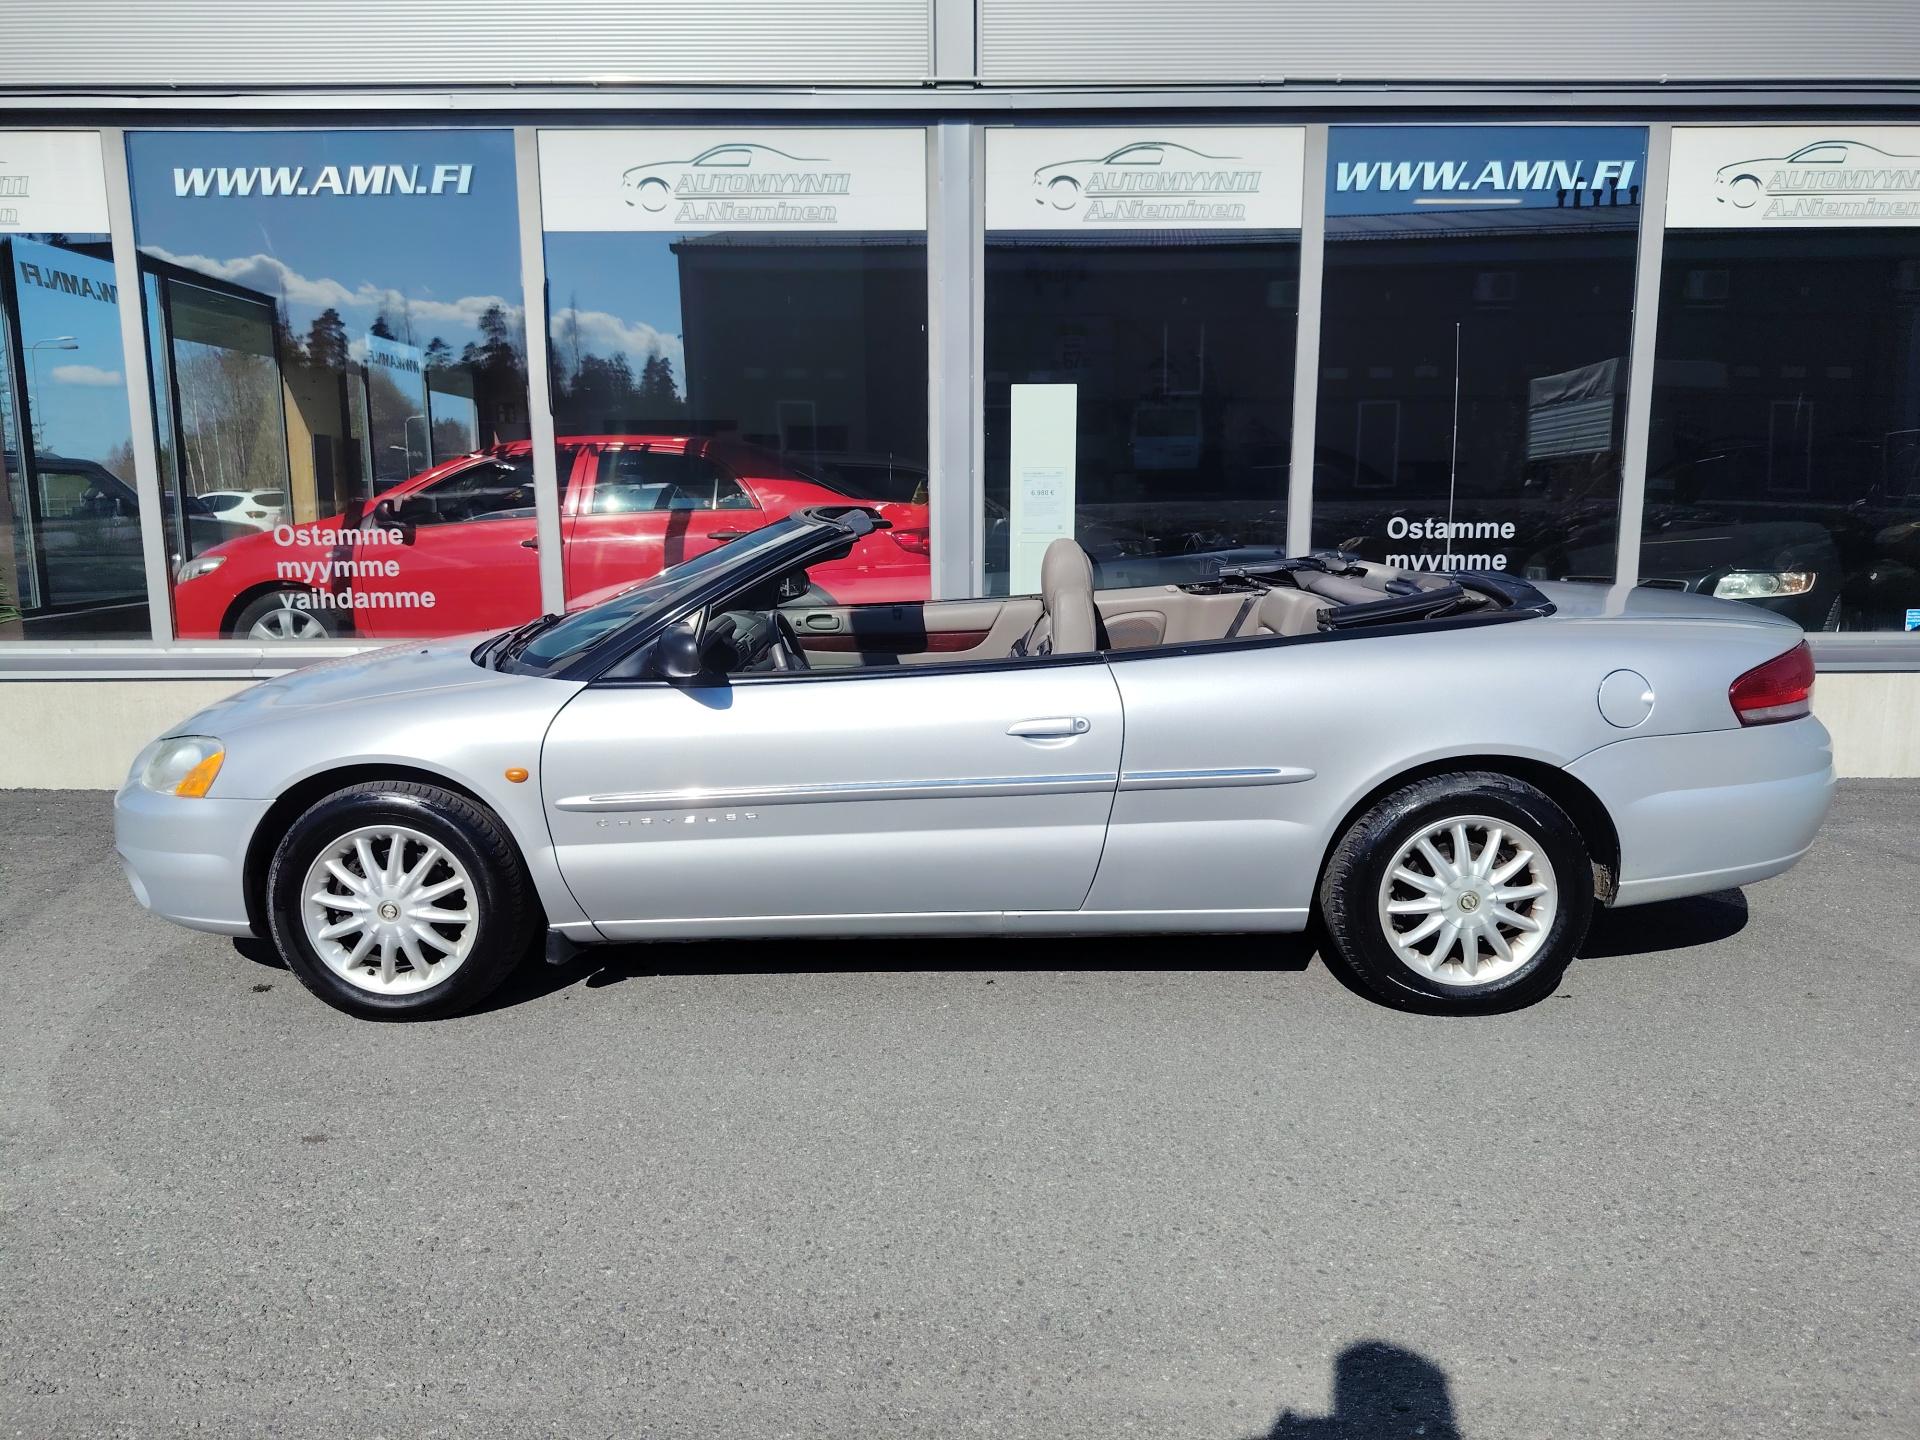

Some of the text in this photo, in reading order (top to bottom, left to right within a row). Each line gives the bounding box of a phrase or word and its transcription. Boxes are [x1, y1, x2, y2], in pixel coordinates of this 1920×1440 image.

[173, 164, 473, 197] WWW.AMN.FI
[674, 173, 851, 193] AUTOMYYNTI
[1084, 171, 1262, 191] AUTOMYYNTI
[1336, 160, 1637, 191] WWW.AMN.FI
[1765, 170, 1920, 189] AUTOMYYN
[674, 202, 838, 222] A.Nieminen
[1083, 200, 1246, 220] A.Nieminen
[273, 524, 404, 547] Ostamme
[1387, 516, 1516, 539] Ostamme
[277, 559, 400, 584] myymme
[279, 586, 436, 610] vaihdamme
